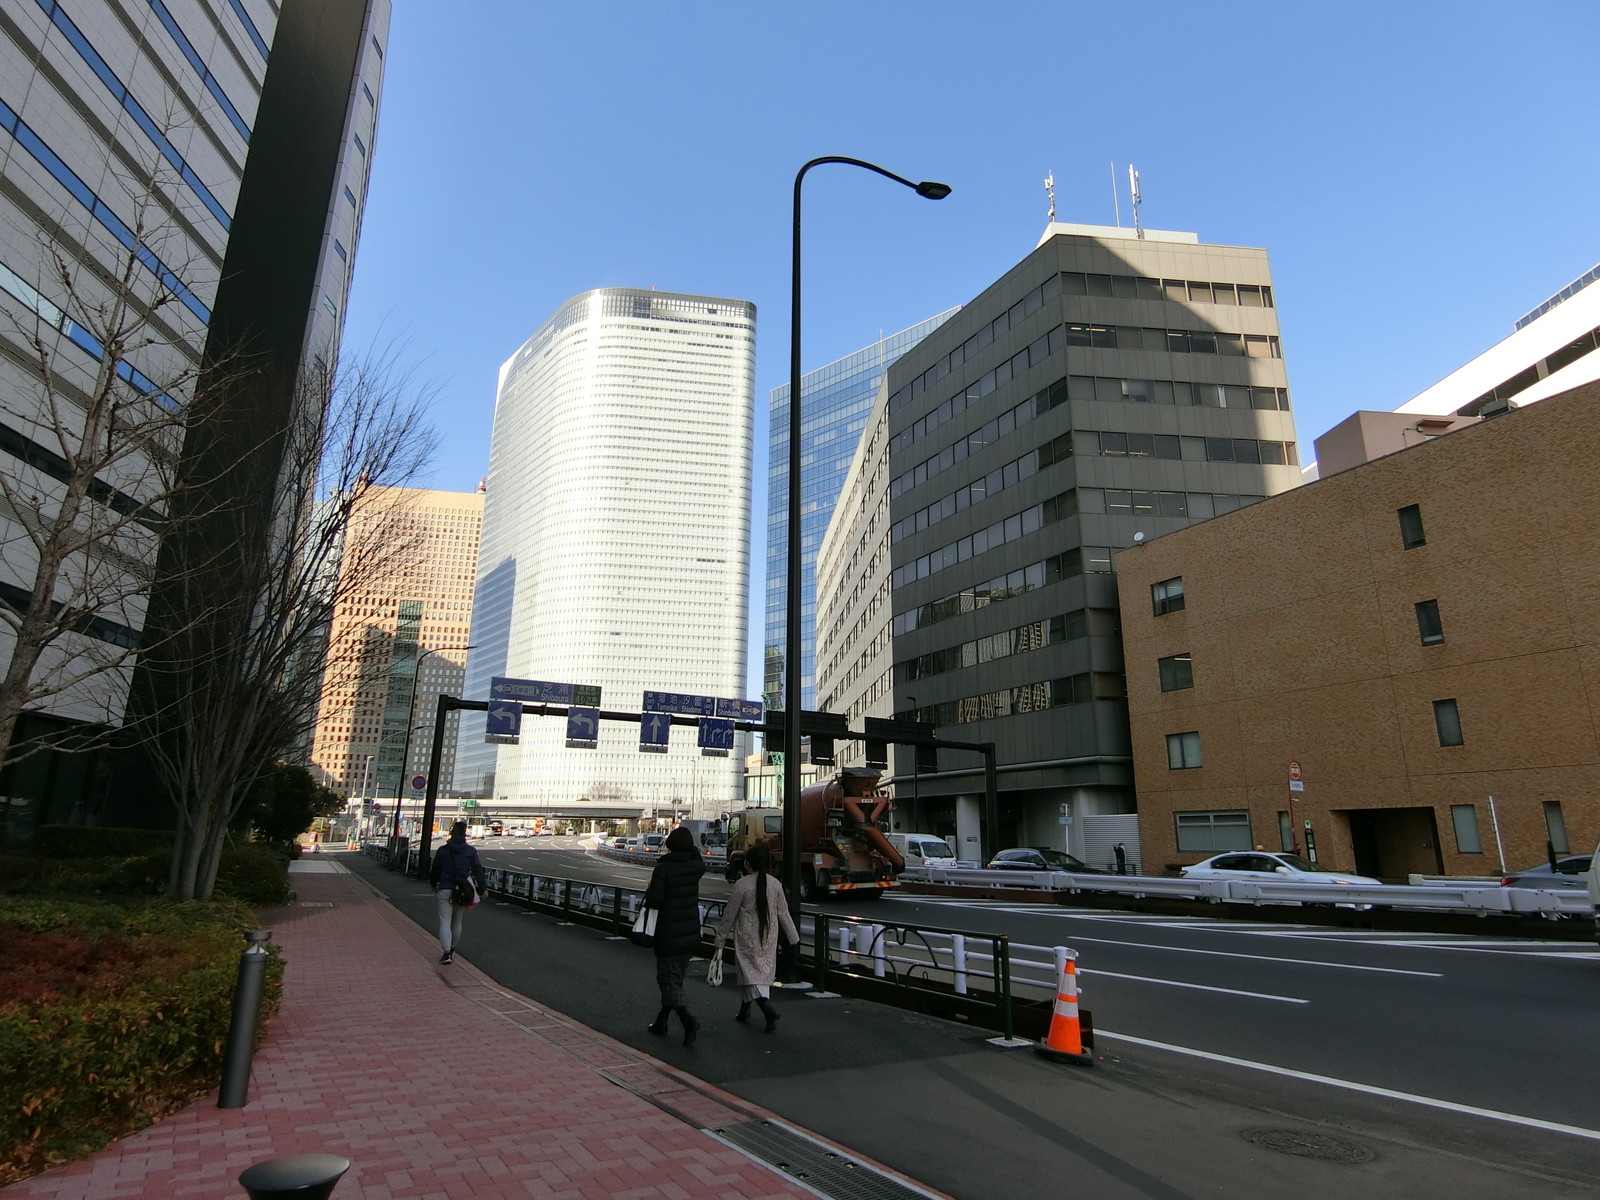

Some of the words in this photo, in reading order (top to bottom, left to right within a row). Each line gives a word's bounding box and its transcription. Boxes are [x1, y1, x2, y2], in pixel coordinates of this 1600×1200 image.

[542, 683, 569, 695] 芝浦
[540, 693, 569, 703] Shibaura
[683, 696, 702, 706] 汐留
[656, 703, 678, 712] Tameike
[681, 705, 702, 713] Shiodome
[719, 699, 741, 710] 新橋
